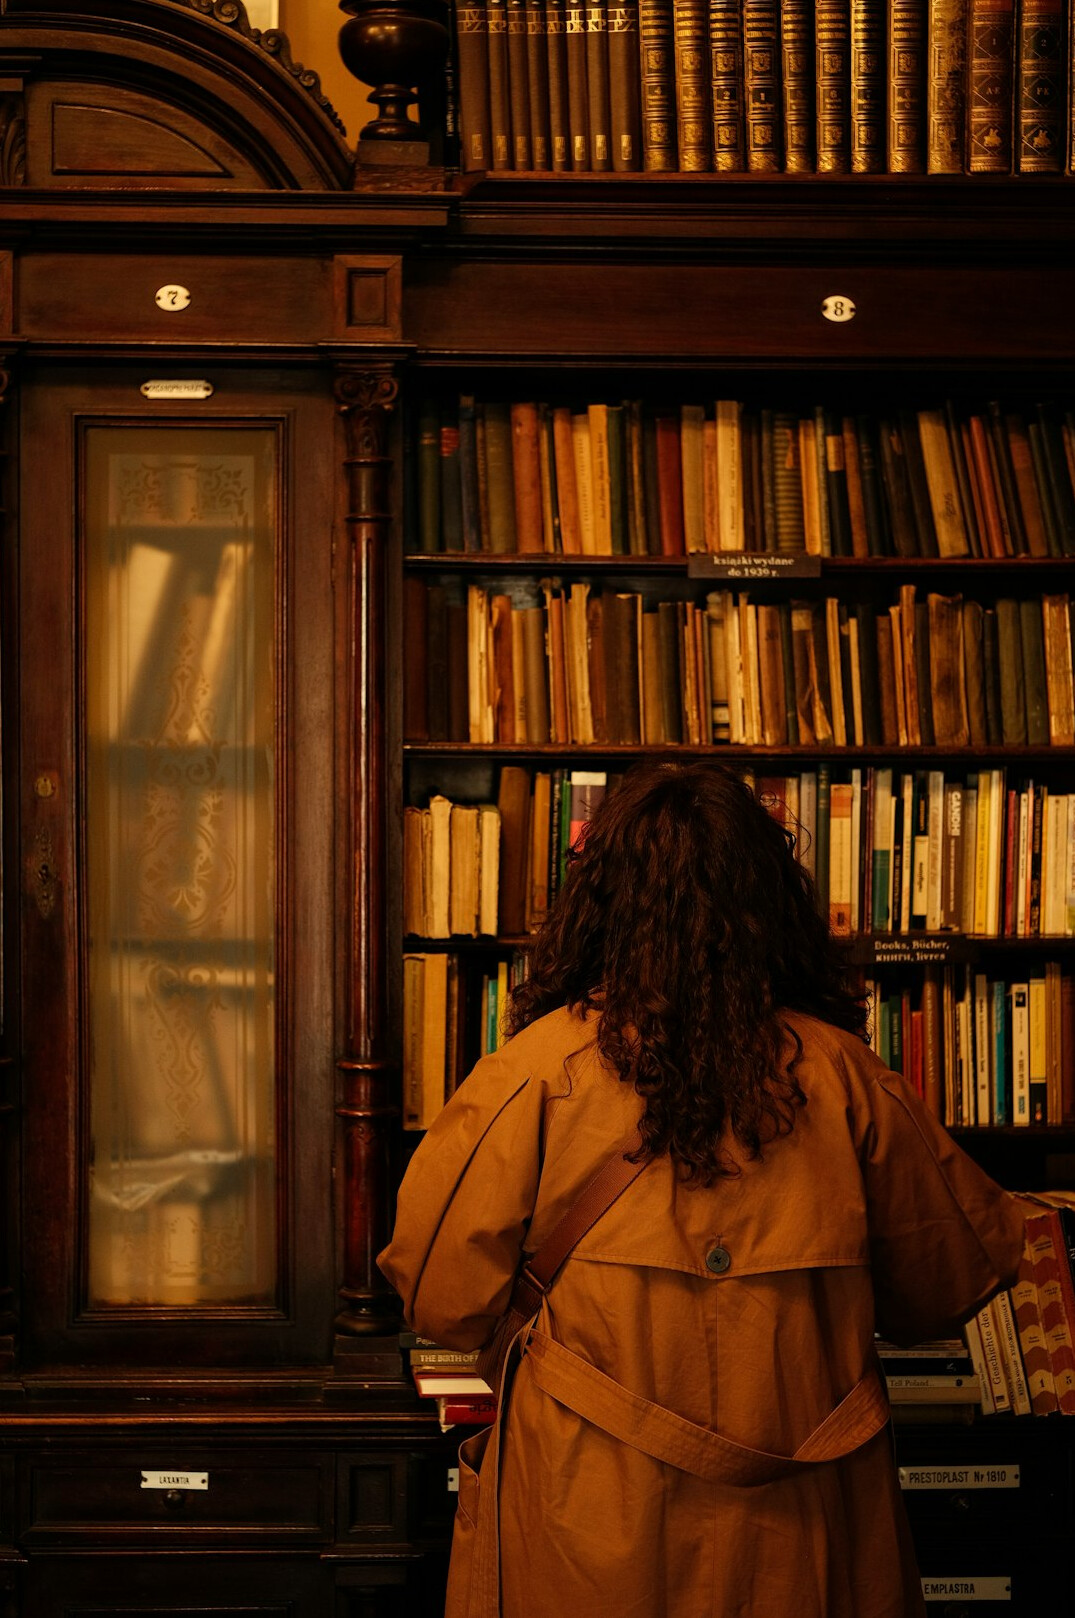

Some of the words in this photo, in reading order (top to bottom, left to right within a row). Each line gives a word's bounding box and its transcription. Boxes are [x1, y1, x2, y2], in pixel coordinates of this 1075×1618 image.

[167, 290, 178, 304] 7
[834, 301, 844, 316] 8
[713, 555, 752, 567] książki
[753, 556, 795, 567] wydane
[727, 567, 741, 577] do
[743, 567, 771, 577] 1939
[771, 569, 780, 577] r.
[951, 790, 962, 837] GANDHI
[874, 940, 910, 951] Books,
[911, 938, 950, 951] Bücher,
[915, 951, 946, 961] livres
[981, 1311, 993, 1328] der
[419, 1354, 436, 1362] THE
[437, 1354, 462, 1362] BIRTH
[463, 1354, 474, 1362] OF
[984, 1328, 1000, 1385] Geschichte
[1039, 1378, 1046, 1388] 1
[1066, 1375, 1072, 1384] 5
[909, 1471, 969, 1484] PRESTOPLAST
[974, 1471, 984, 1483] Nr
[986, 1470, 1007, 1482] 1810
[924, 1583, 976, 1594] EMPLASTRA
